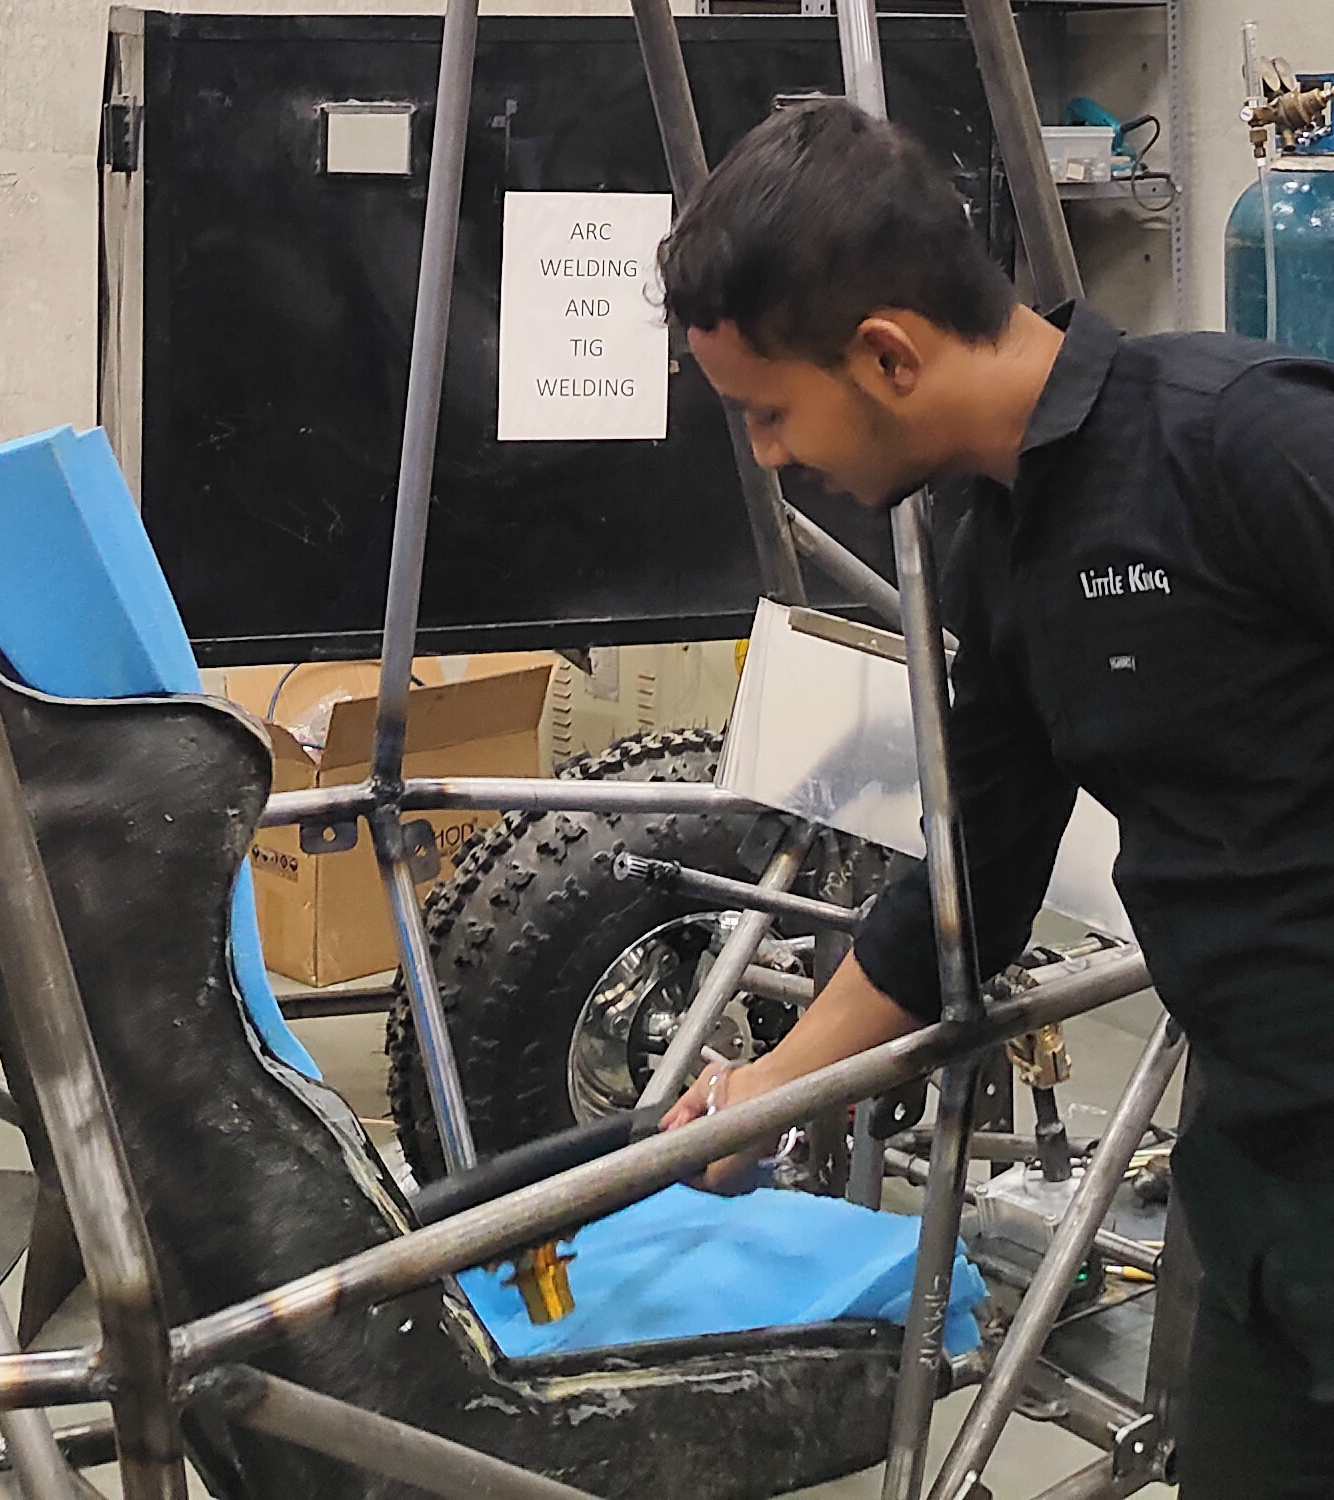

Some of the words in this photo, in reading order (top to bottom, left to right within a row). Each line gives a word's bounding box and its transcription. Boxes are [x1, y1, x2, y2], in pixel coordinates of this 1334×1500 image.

[569, 222, 613, 241] ARC
[539, 258, 639, 278] WELDING
[564, 298, 611, 317] AND
[569, 338, 604, 357] TIG
[536, 378, 635, 398] WELDING
